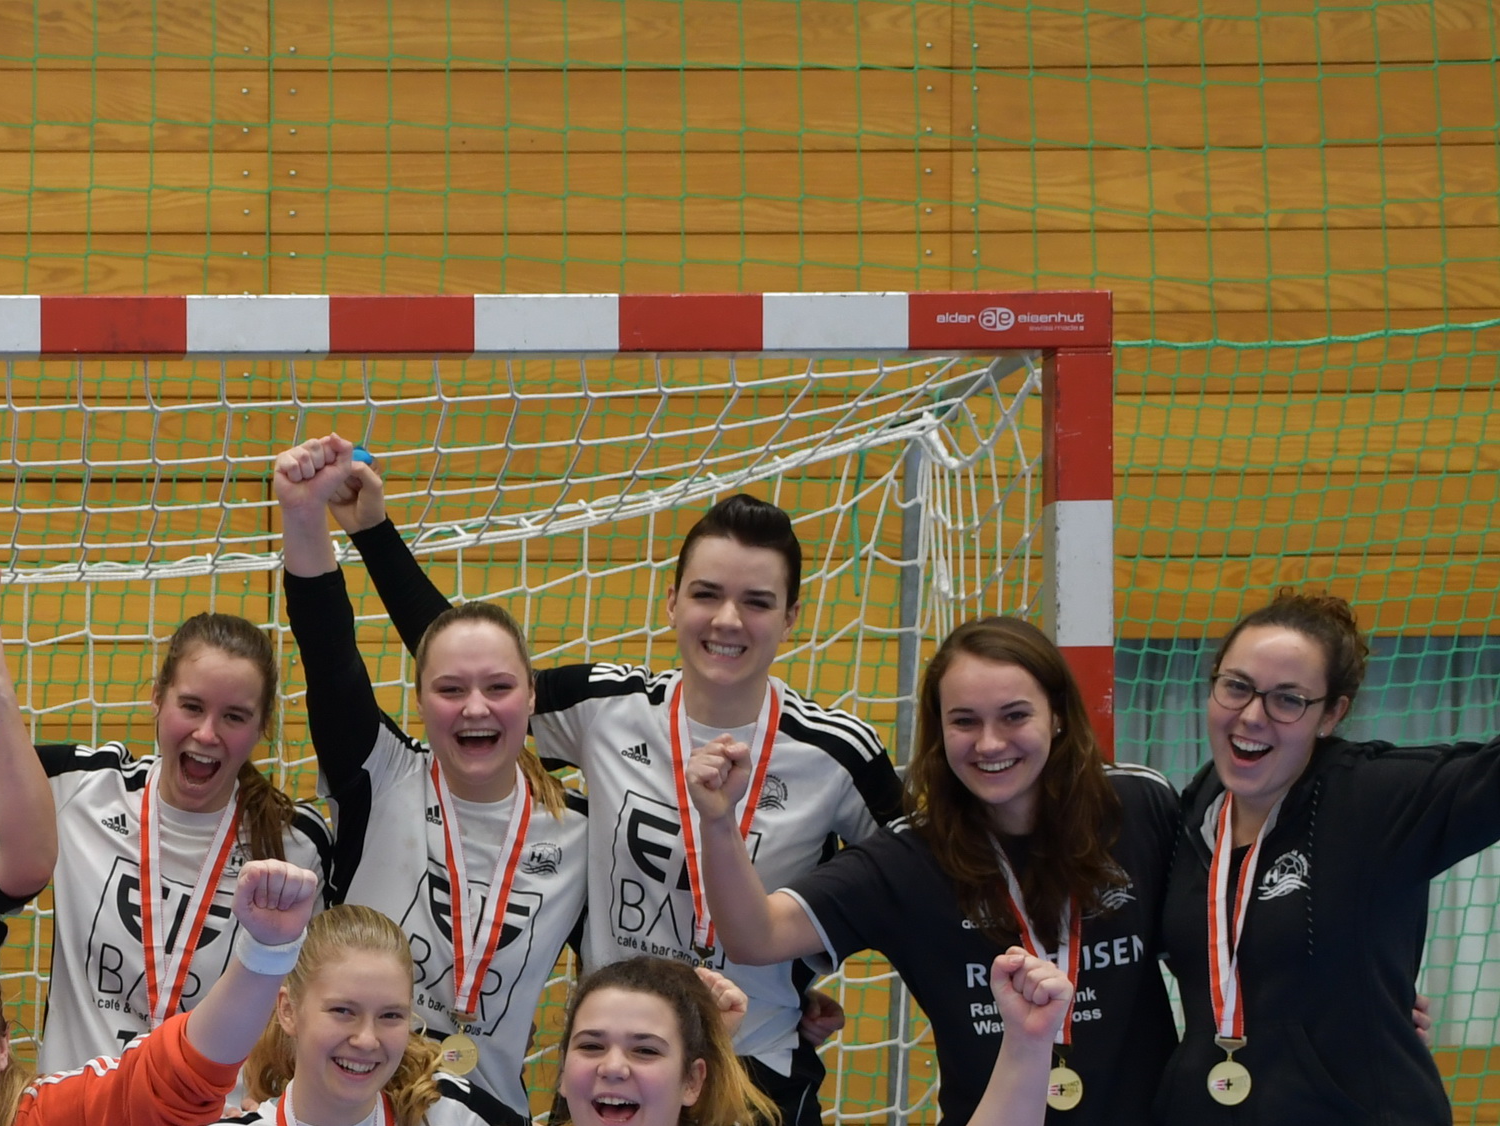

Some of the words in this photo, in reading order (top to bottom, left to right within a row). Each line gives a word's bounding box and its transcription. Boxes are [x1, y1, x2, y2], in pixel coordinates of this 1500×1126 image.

[936, 312, 975, 323] alder
[1017, 312, 1084, 323] eisenhut
[621, 750, 652, 766] adidas
[101, 818, 130, 836] adidas
[641, 940, 648, 952] &
[651, 943, 670, 956] bar
[123, 1002, 132, 1014] &
[428, 997, 446, 1012] bar
